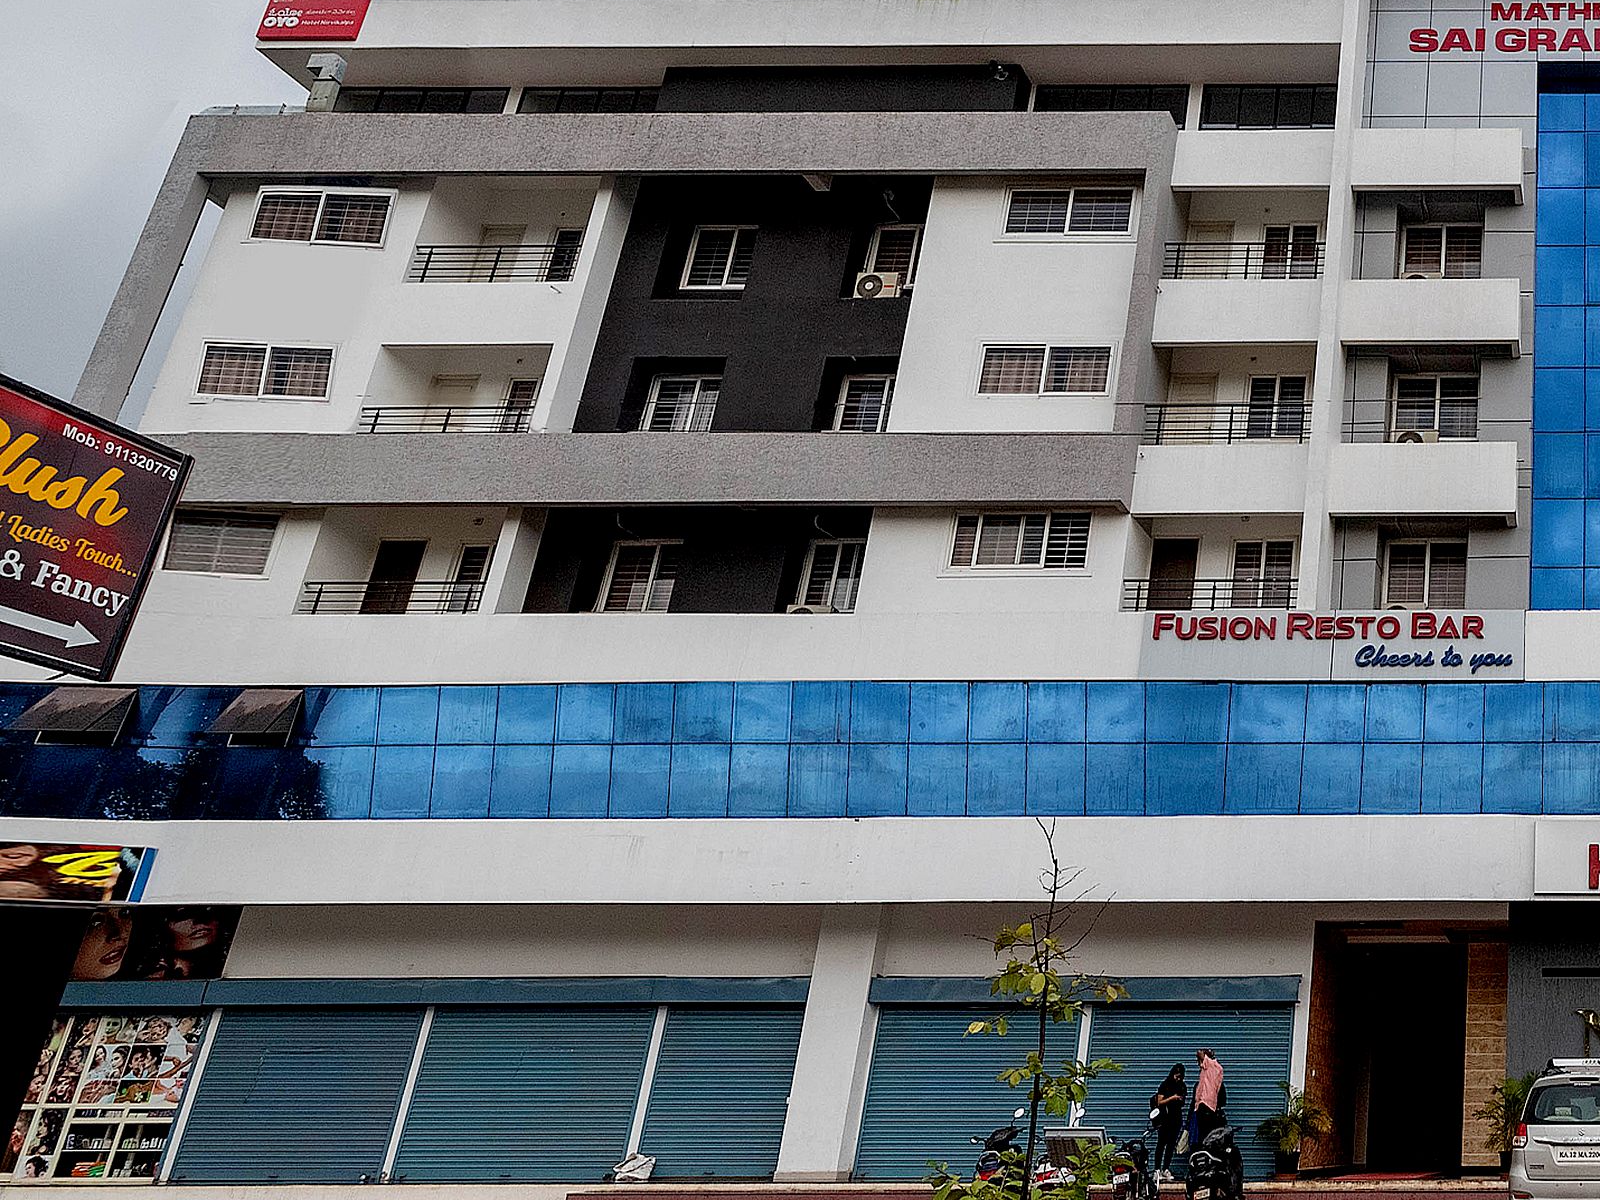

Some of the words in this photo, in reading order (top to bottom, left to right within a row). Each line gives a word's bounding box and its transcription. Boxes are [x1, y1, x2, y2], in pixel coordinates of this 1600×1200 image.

[263, 16, 300, 28] OYO
[1408, 27, 1486, 53] SAI
[62, 423, 101, 450] Mob:
[7, 515, 71, 552] Ladies
[0, 550, 25, 580] &
[31, 560, 130, 617] Fancy
[1353, 644, 1434, 668] Cheers
[1440, 644, 1463, 667] to
[1469, 652, 1514, 675] you
